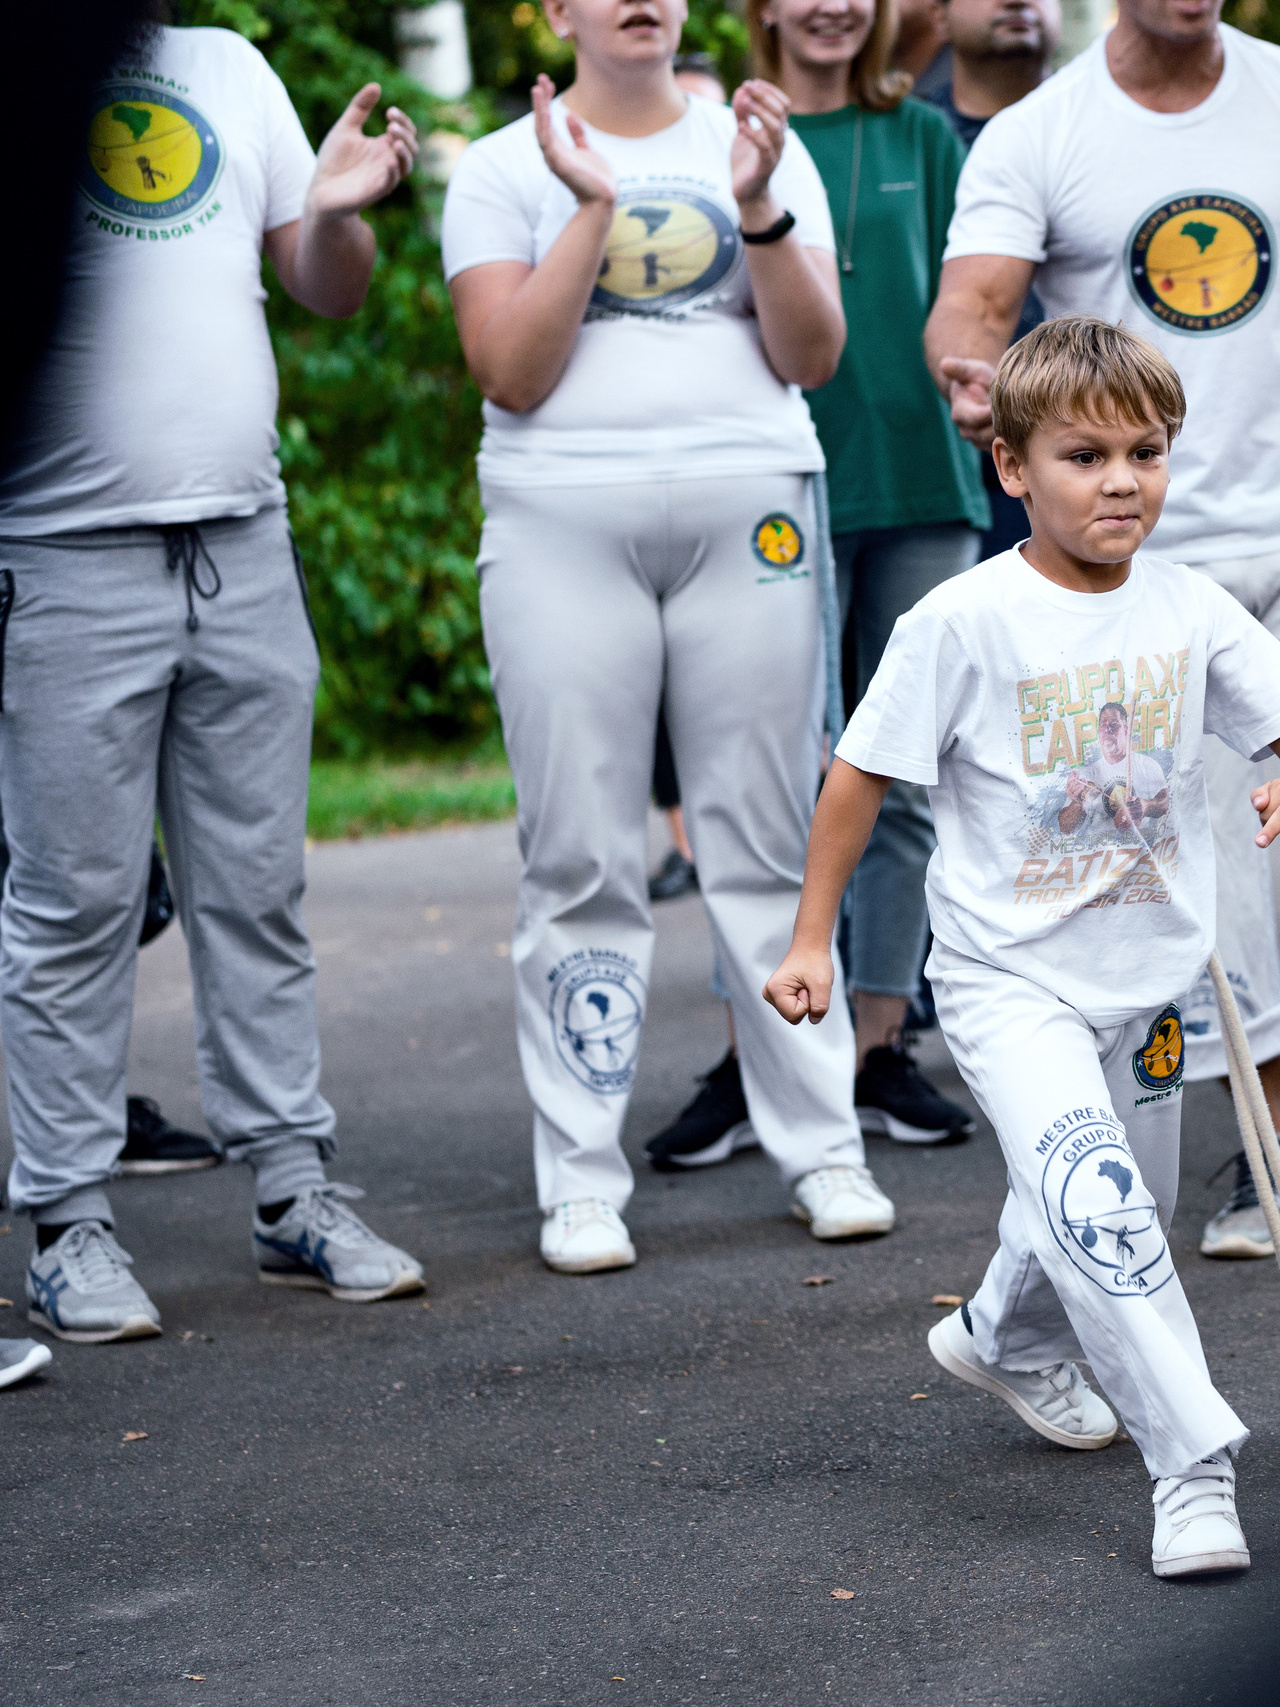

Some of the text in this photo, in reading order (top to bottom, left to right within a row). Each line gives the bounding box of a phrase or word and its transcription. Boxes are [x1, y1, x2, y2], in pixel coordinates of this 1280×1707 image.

[85, 210, 194, 241] PROFESSOR
[1016, 658, 1126, 725] GRUPO
[1050, 830, 1117, 855] MESTRE
[1013, 884, 1090, 905] TROCA
[1134, 1089, 1172, 1108] Mestre
[1035, 1107, 1097, 1155] MESTRE
[1062, 1129, 1118, 1163] GRUPO
